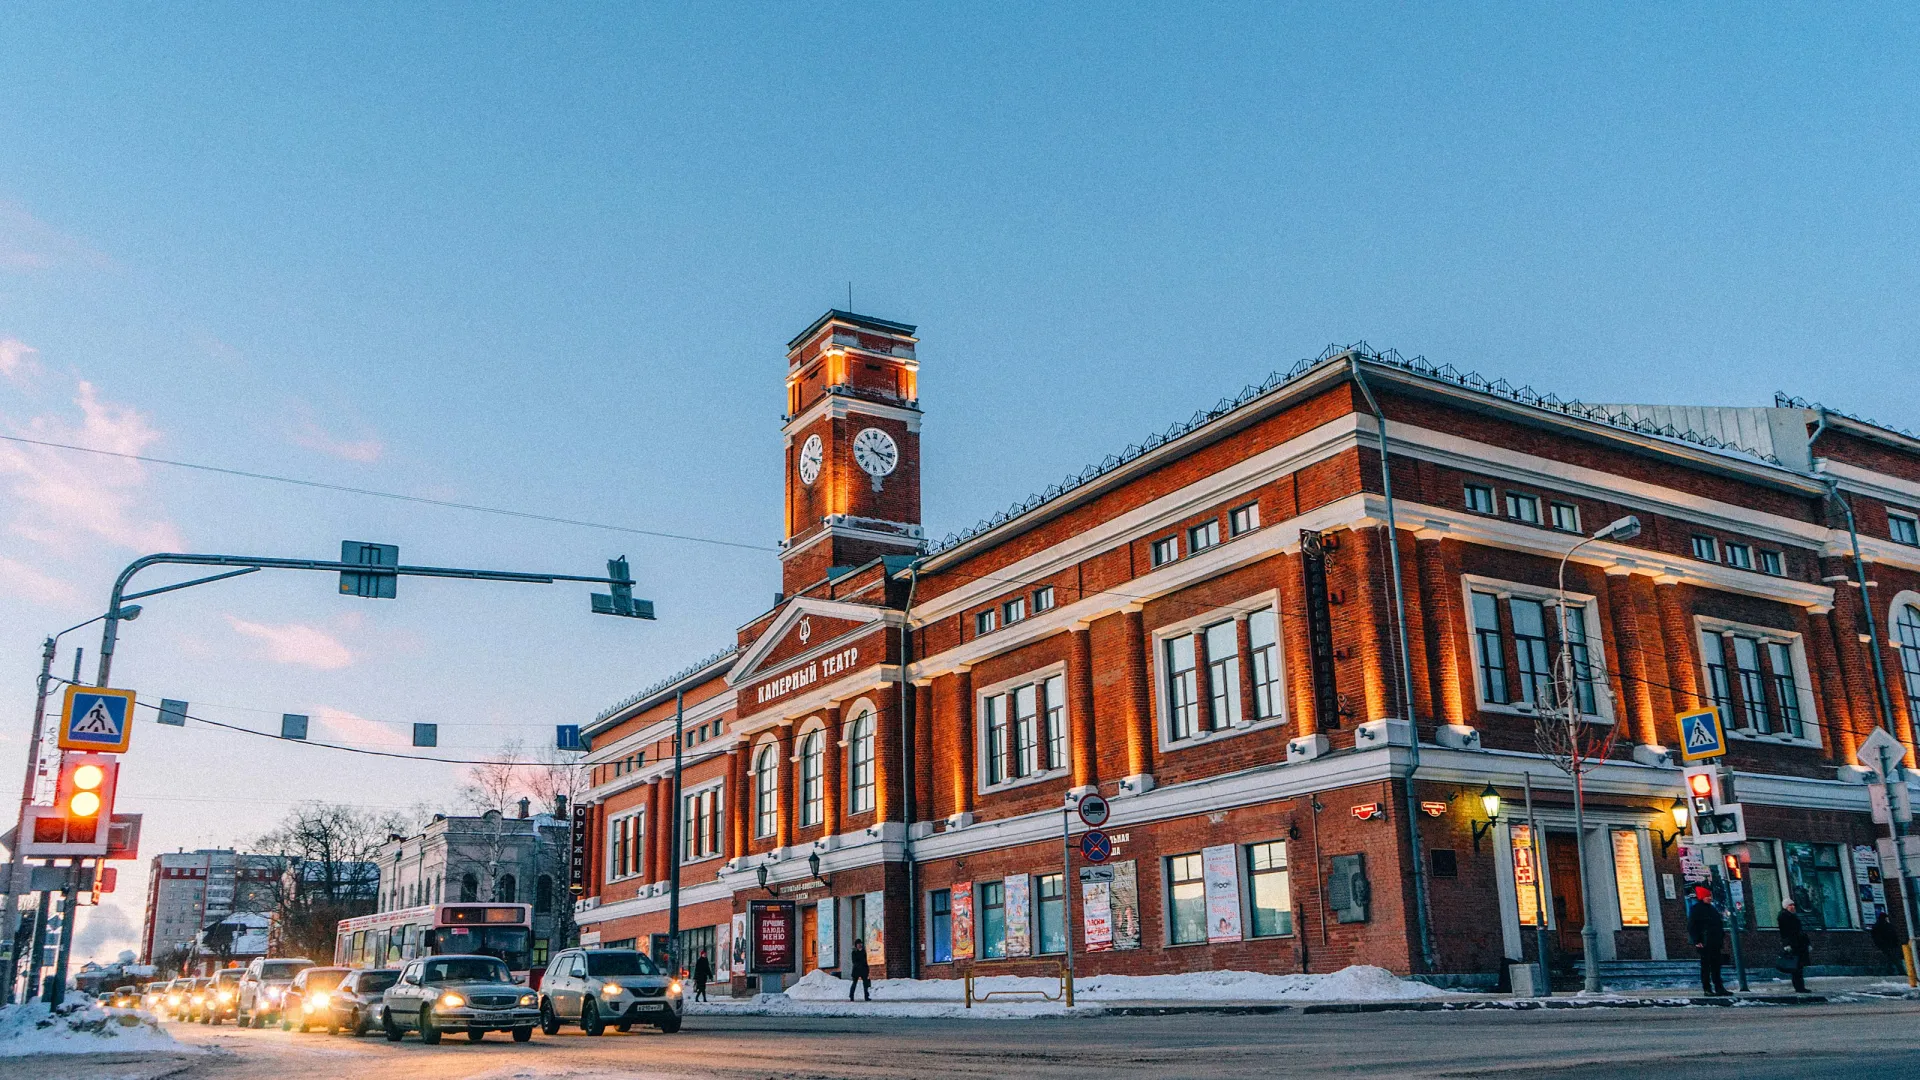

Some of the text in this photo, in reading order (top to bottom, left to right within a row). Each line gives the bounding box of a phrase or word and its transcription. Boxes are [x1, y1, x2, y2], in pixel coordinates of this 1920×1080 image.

[758, 647, 858, 704] КАМЕРНЫЙ ТЕАТР
[574, 808, 585, 879] ОРУЖИЕ
[1517, 866, 1533, 884] 53
[762, 919, 785, 927] ЛУЧШИЕ
